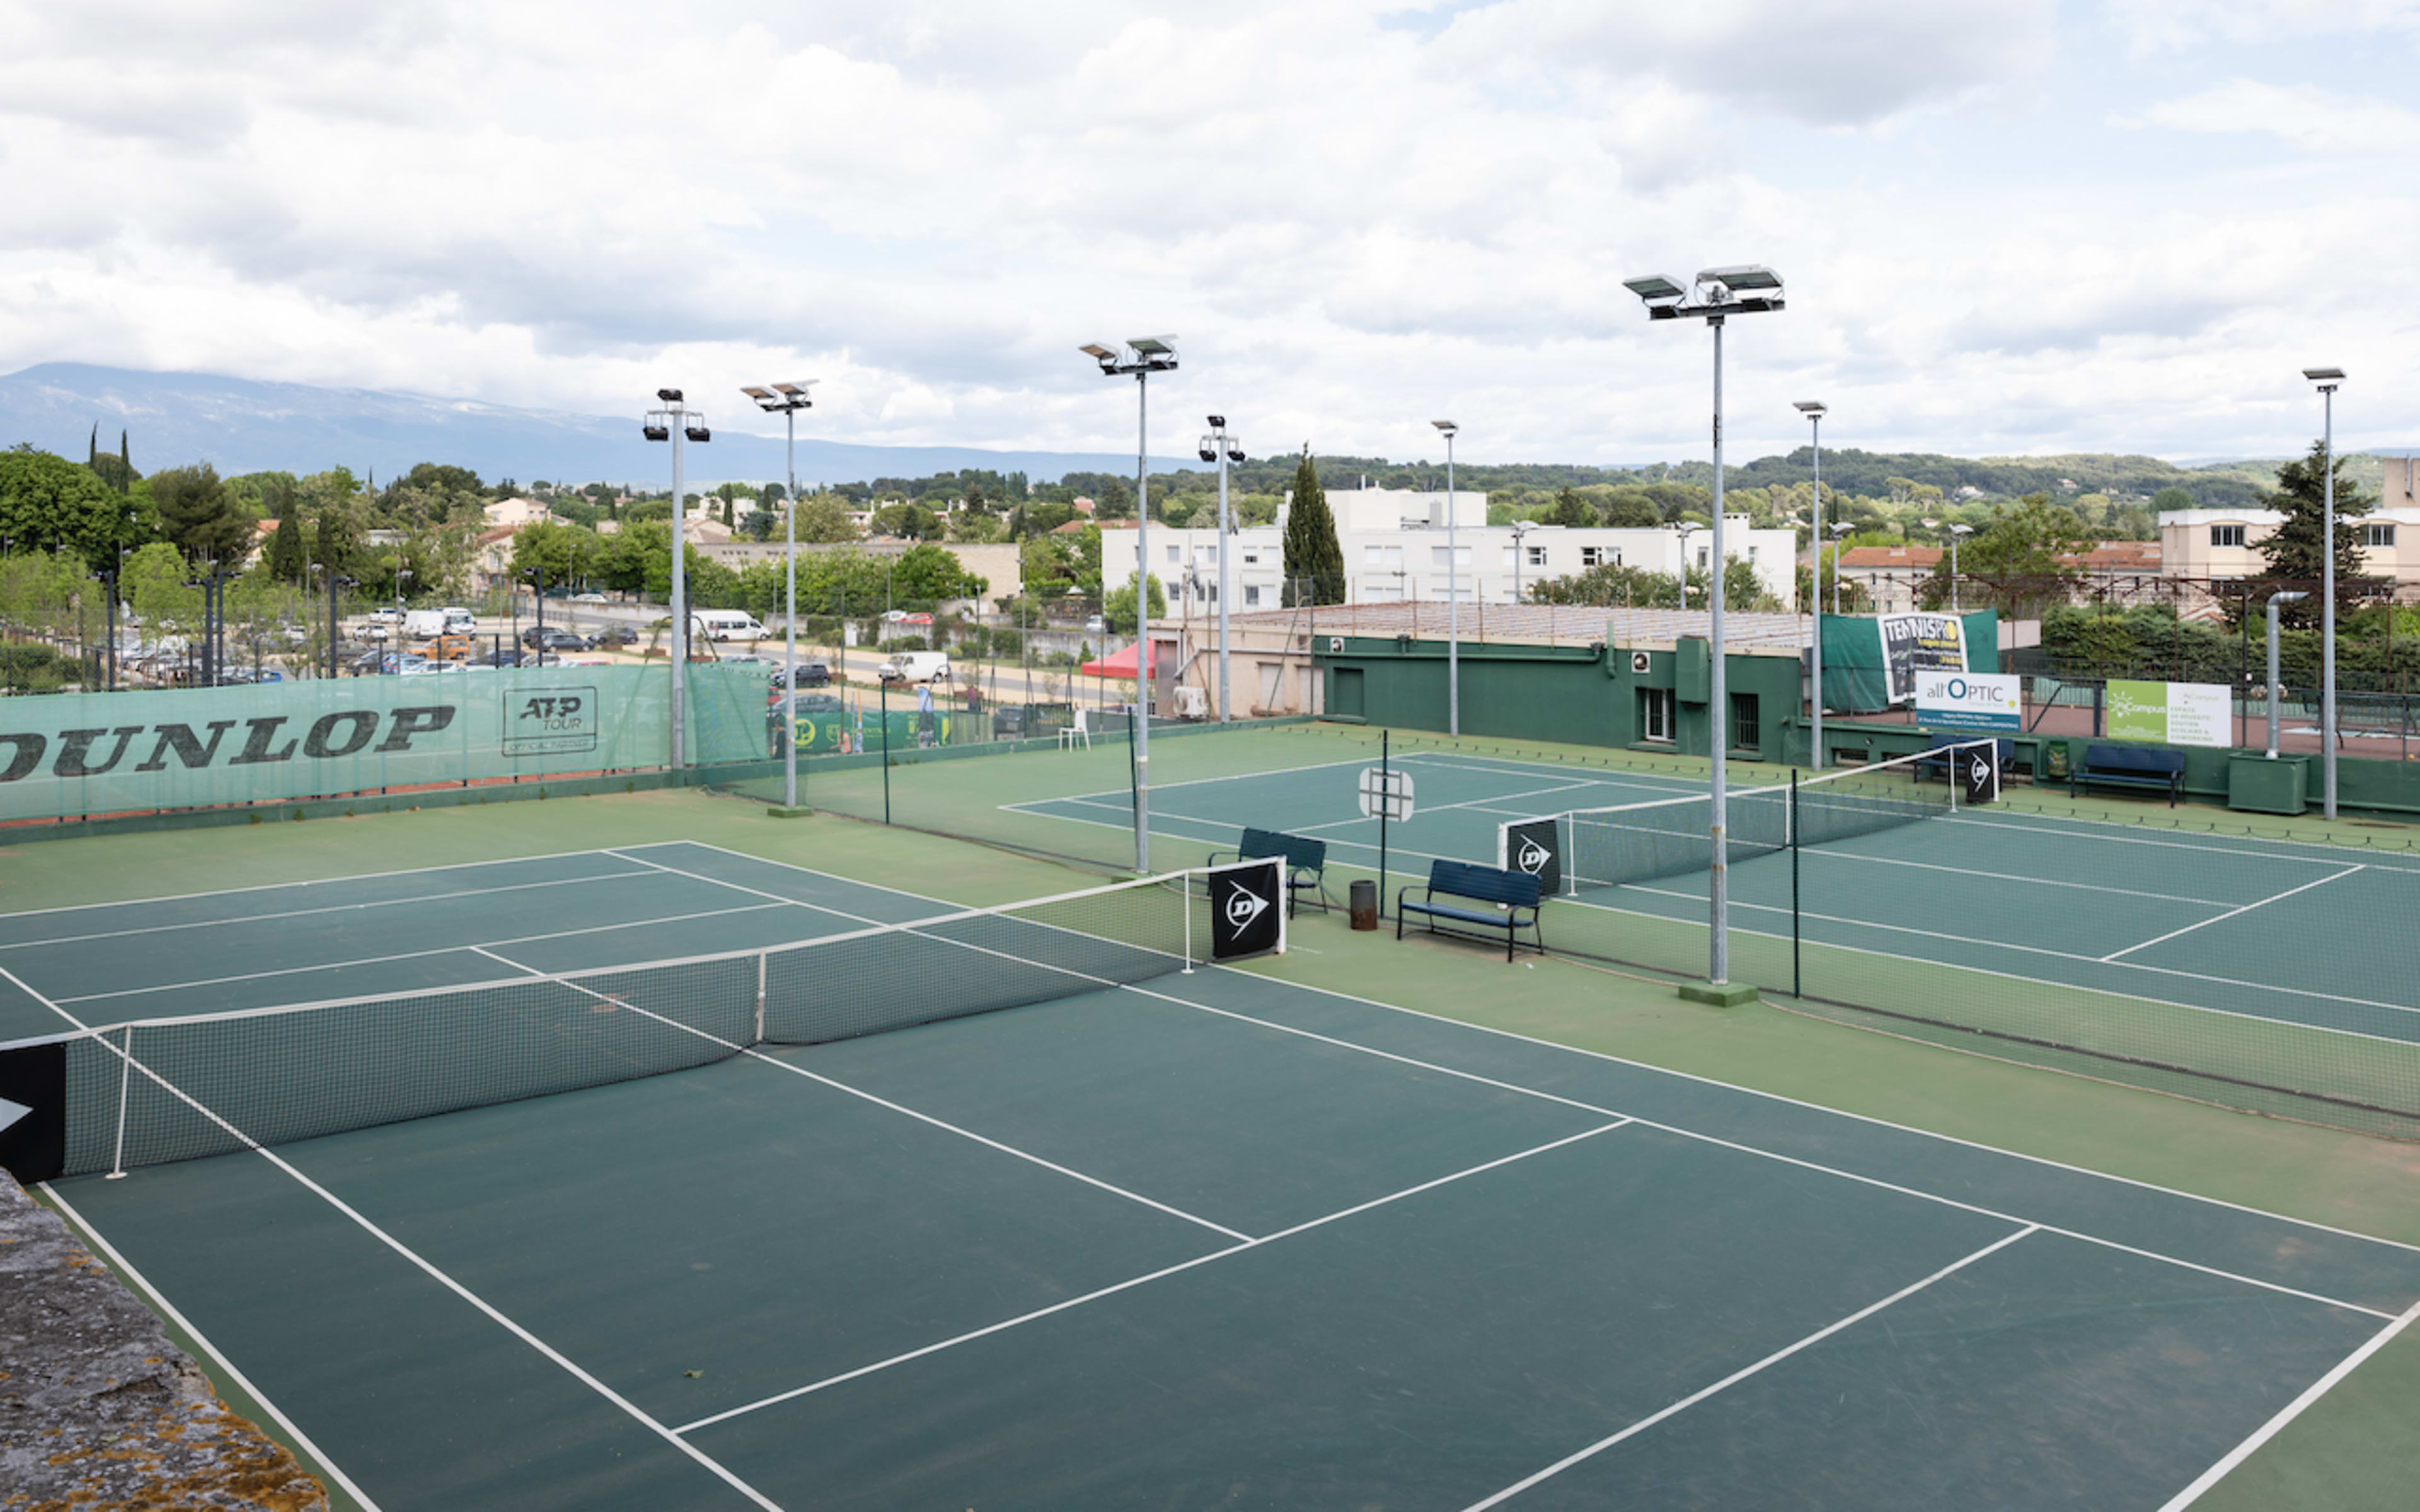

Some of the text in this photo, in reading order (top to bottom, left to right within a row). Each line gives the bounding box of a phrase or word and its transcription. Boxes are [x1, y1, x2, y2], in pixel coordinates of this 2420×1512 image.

[520, 697, 581, 718] ATP
[543, 718, 581, 730] TOUR
[0, 705, 456, 782] DUNLOP
